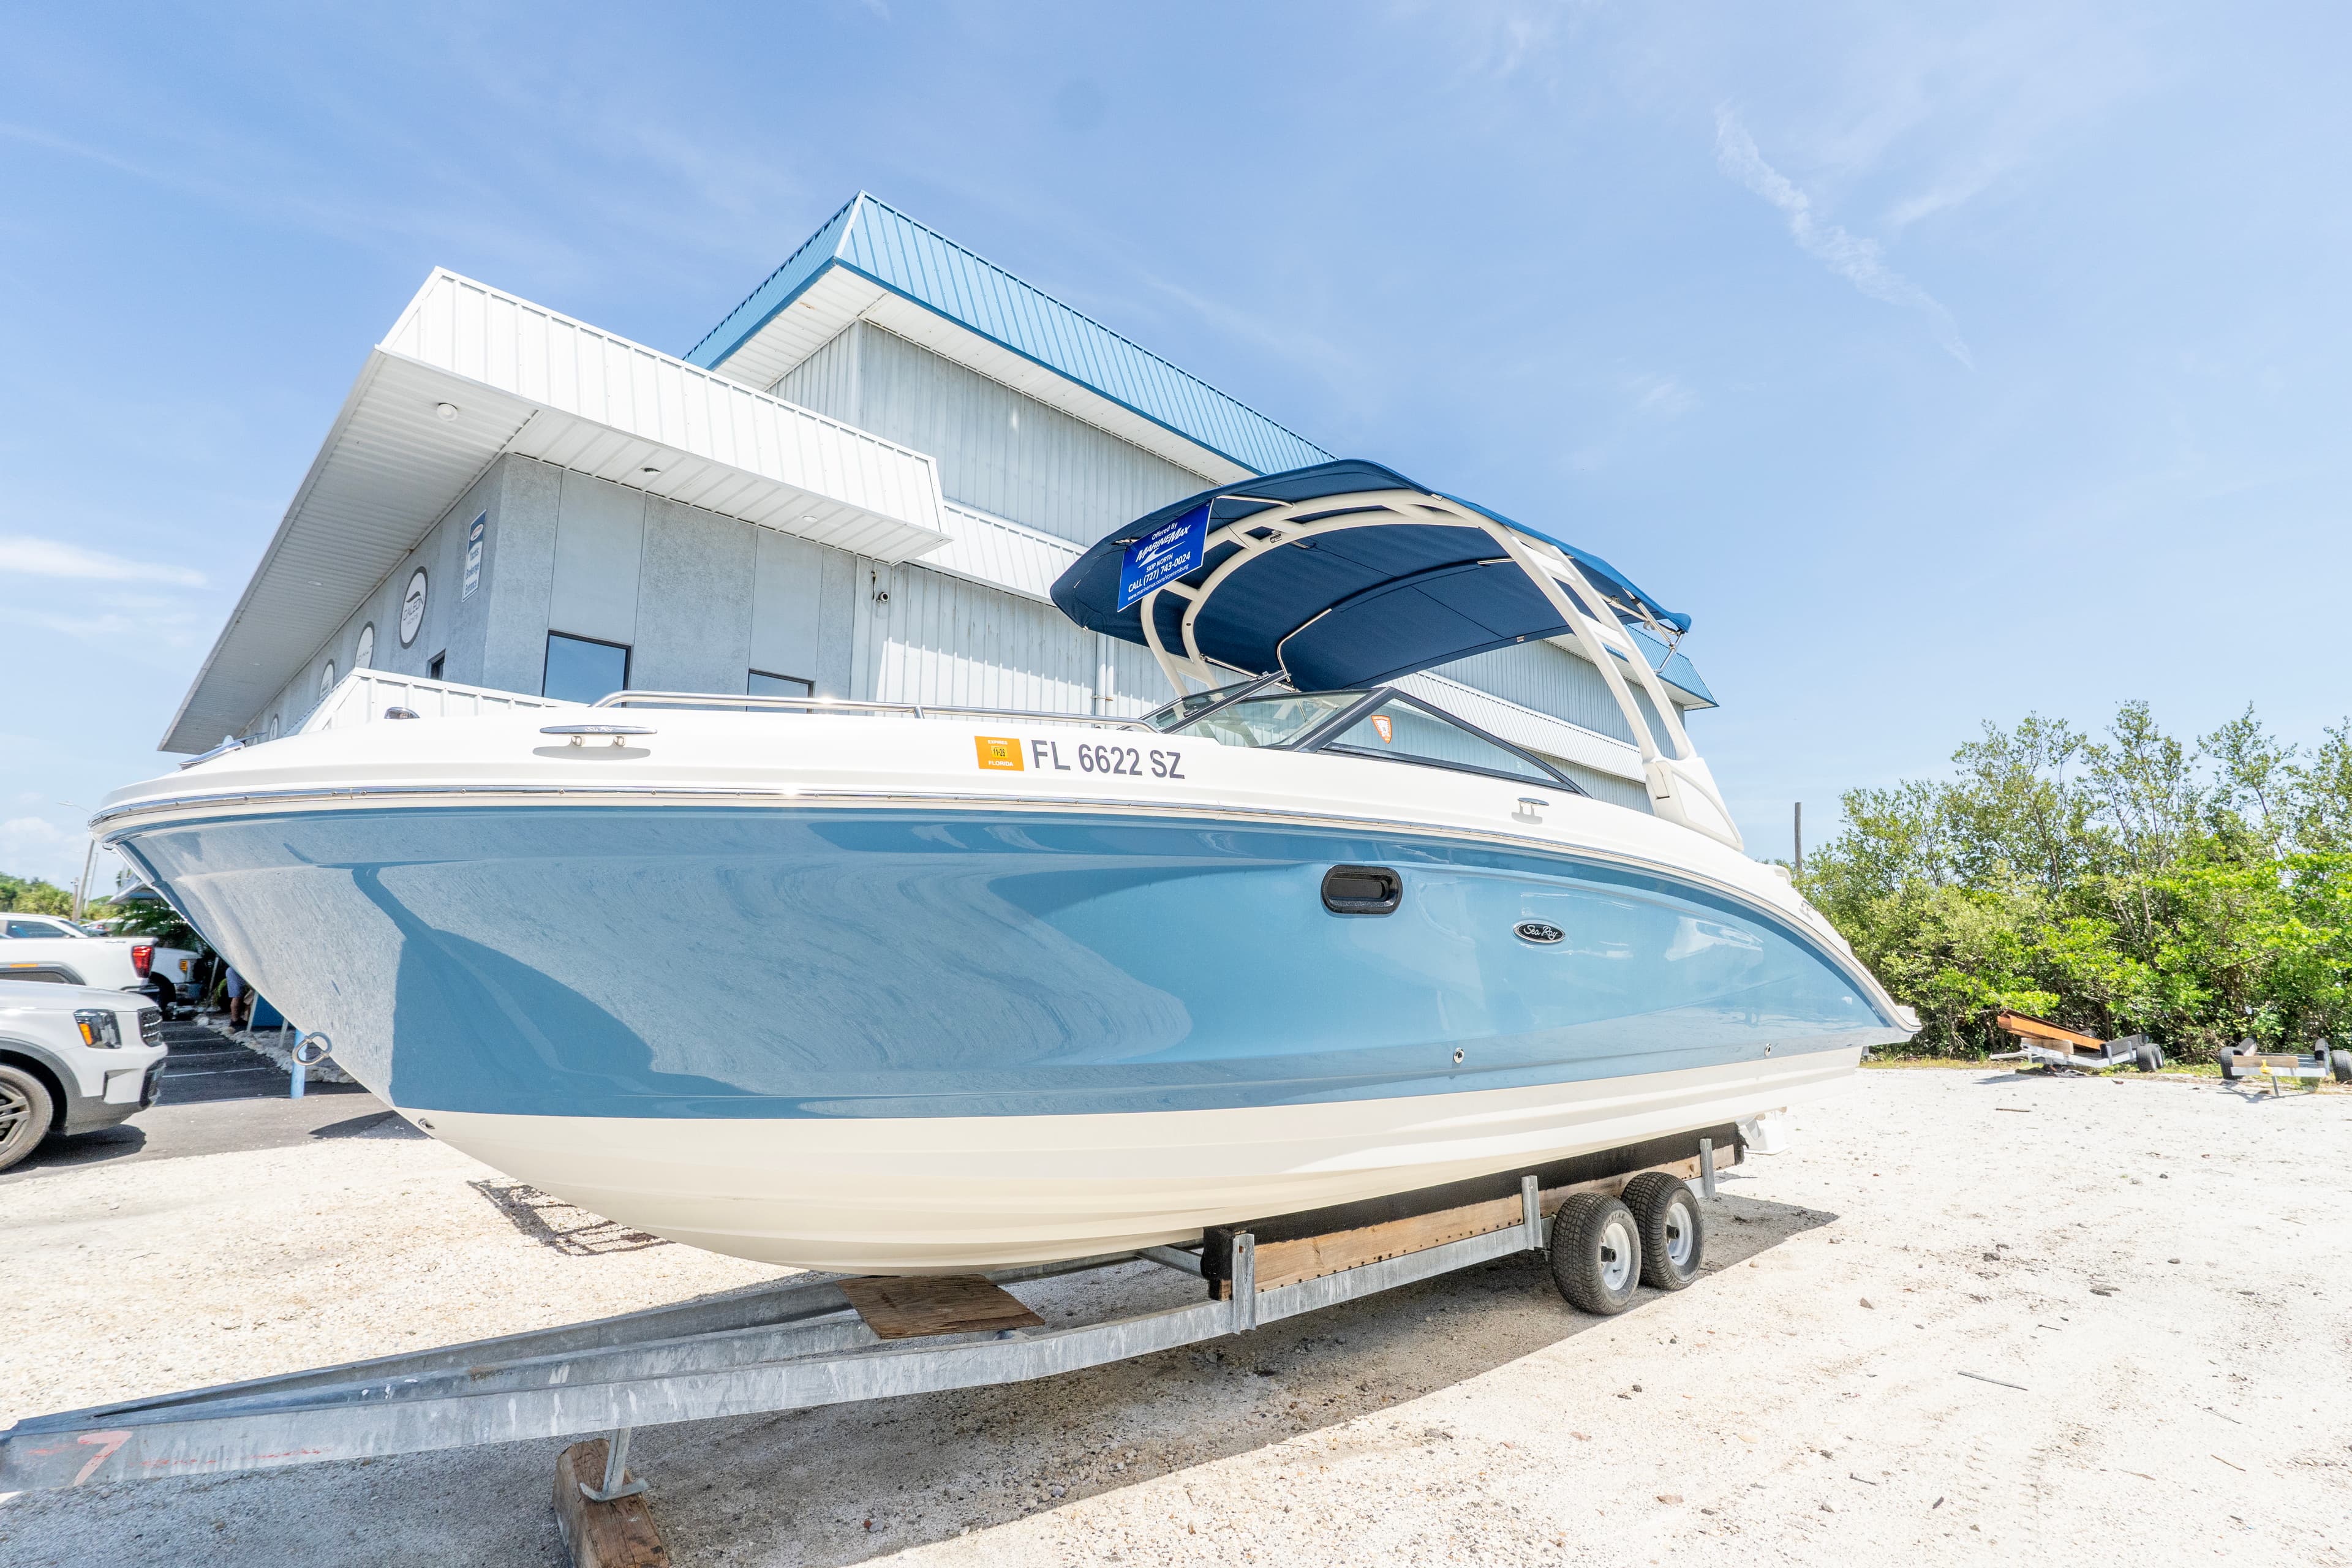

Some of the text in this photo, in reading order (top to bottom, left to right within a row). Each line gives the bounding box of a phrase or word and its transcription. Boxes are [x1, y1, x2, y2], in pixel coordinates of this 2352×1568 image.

[1152, 525, 1170, 540] Offered
[1146, 552, 1174, 573] SKIP NORTH
[1128, 551, 1191, 593] CALL (727) 743-0024
[993, 747, 1006, 757] 11-26
[1031, 739, 1185, 780] FL 6622 SZ
[1523, 925, 1558, 940] Sea Ray
